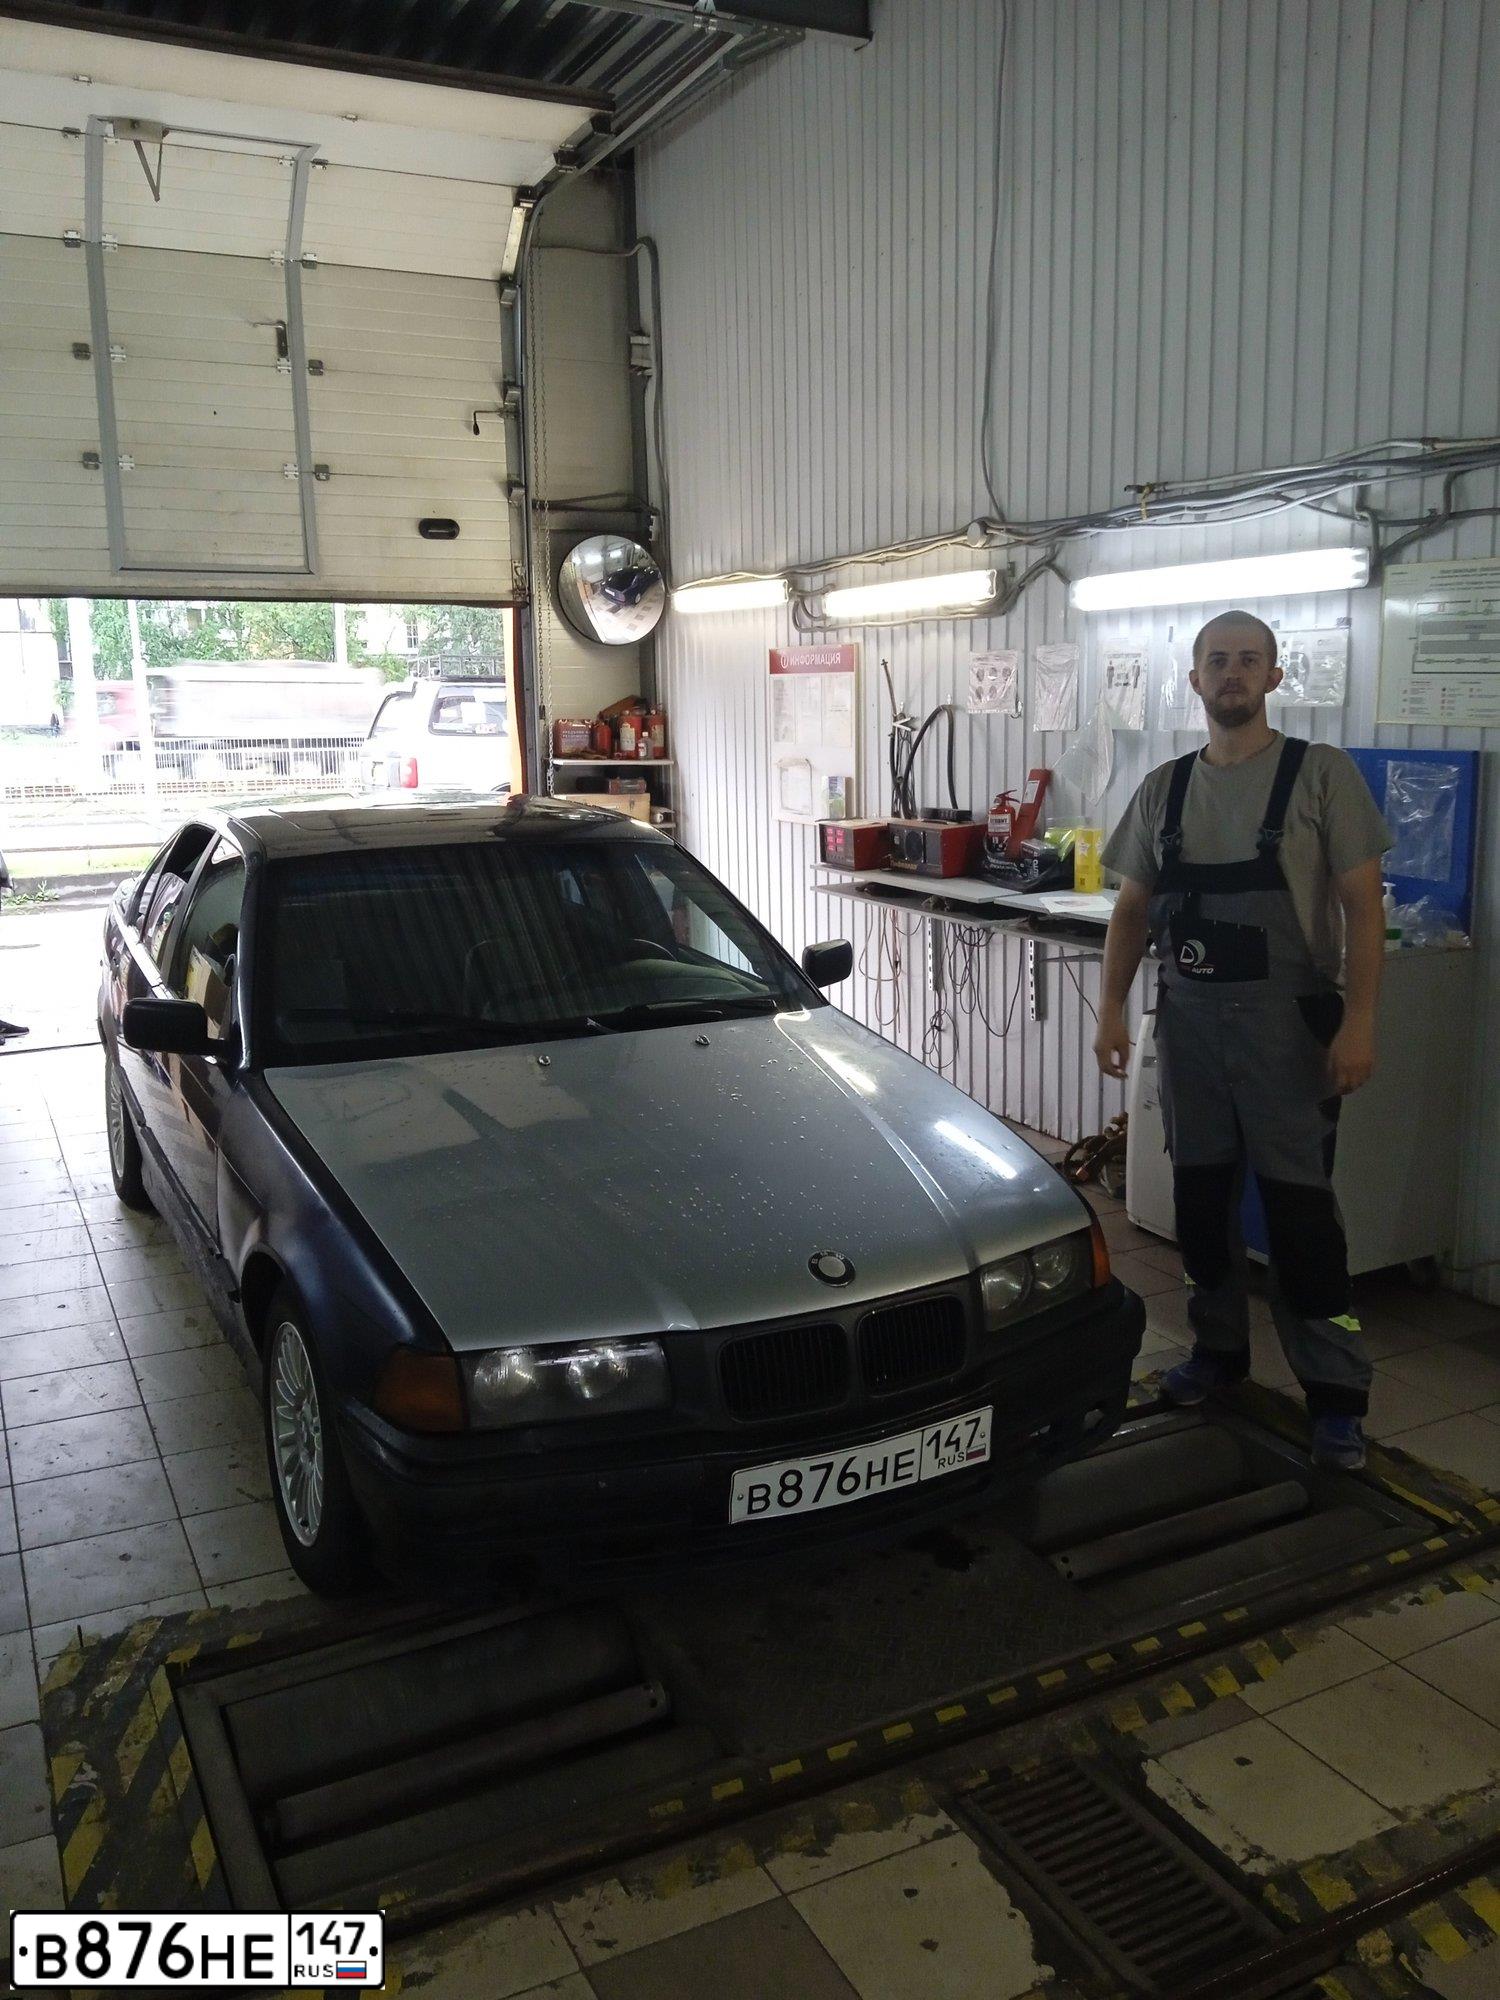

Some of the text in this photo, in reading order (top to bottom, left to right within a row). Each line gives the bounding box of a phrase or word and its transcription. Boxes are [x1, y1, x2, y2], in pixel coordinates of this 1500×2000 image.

[789, 652, 841, 667] ИНФОРМАЦИЯ
[1191, 967, 1214, 975] AUTO
[747, 1417, 982, 1515] В876НЕ 147
[937, 1450, 965, 1469] RUS
